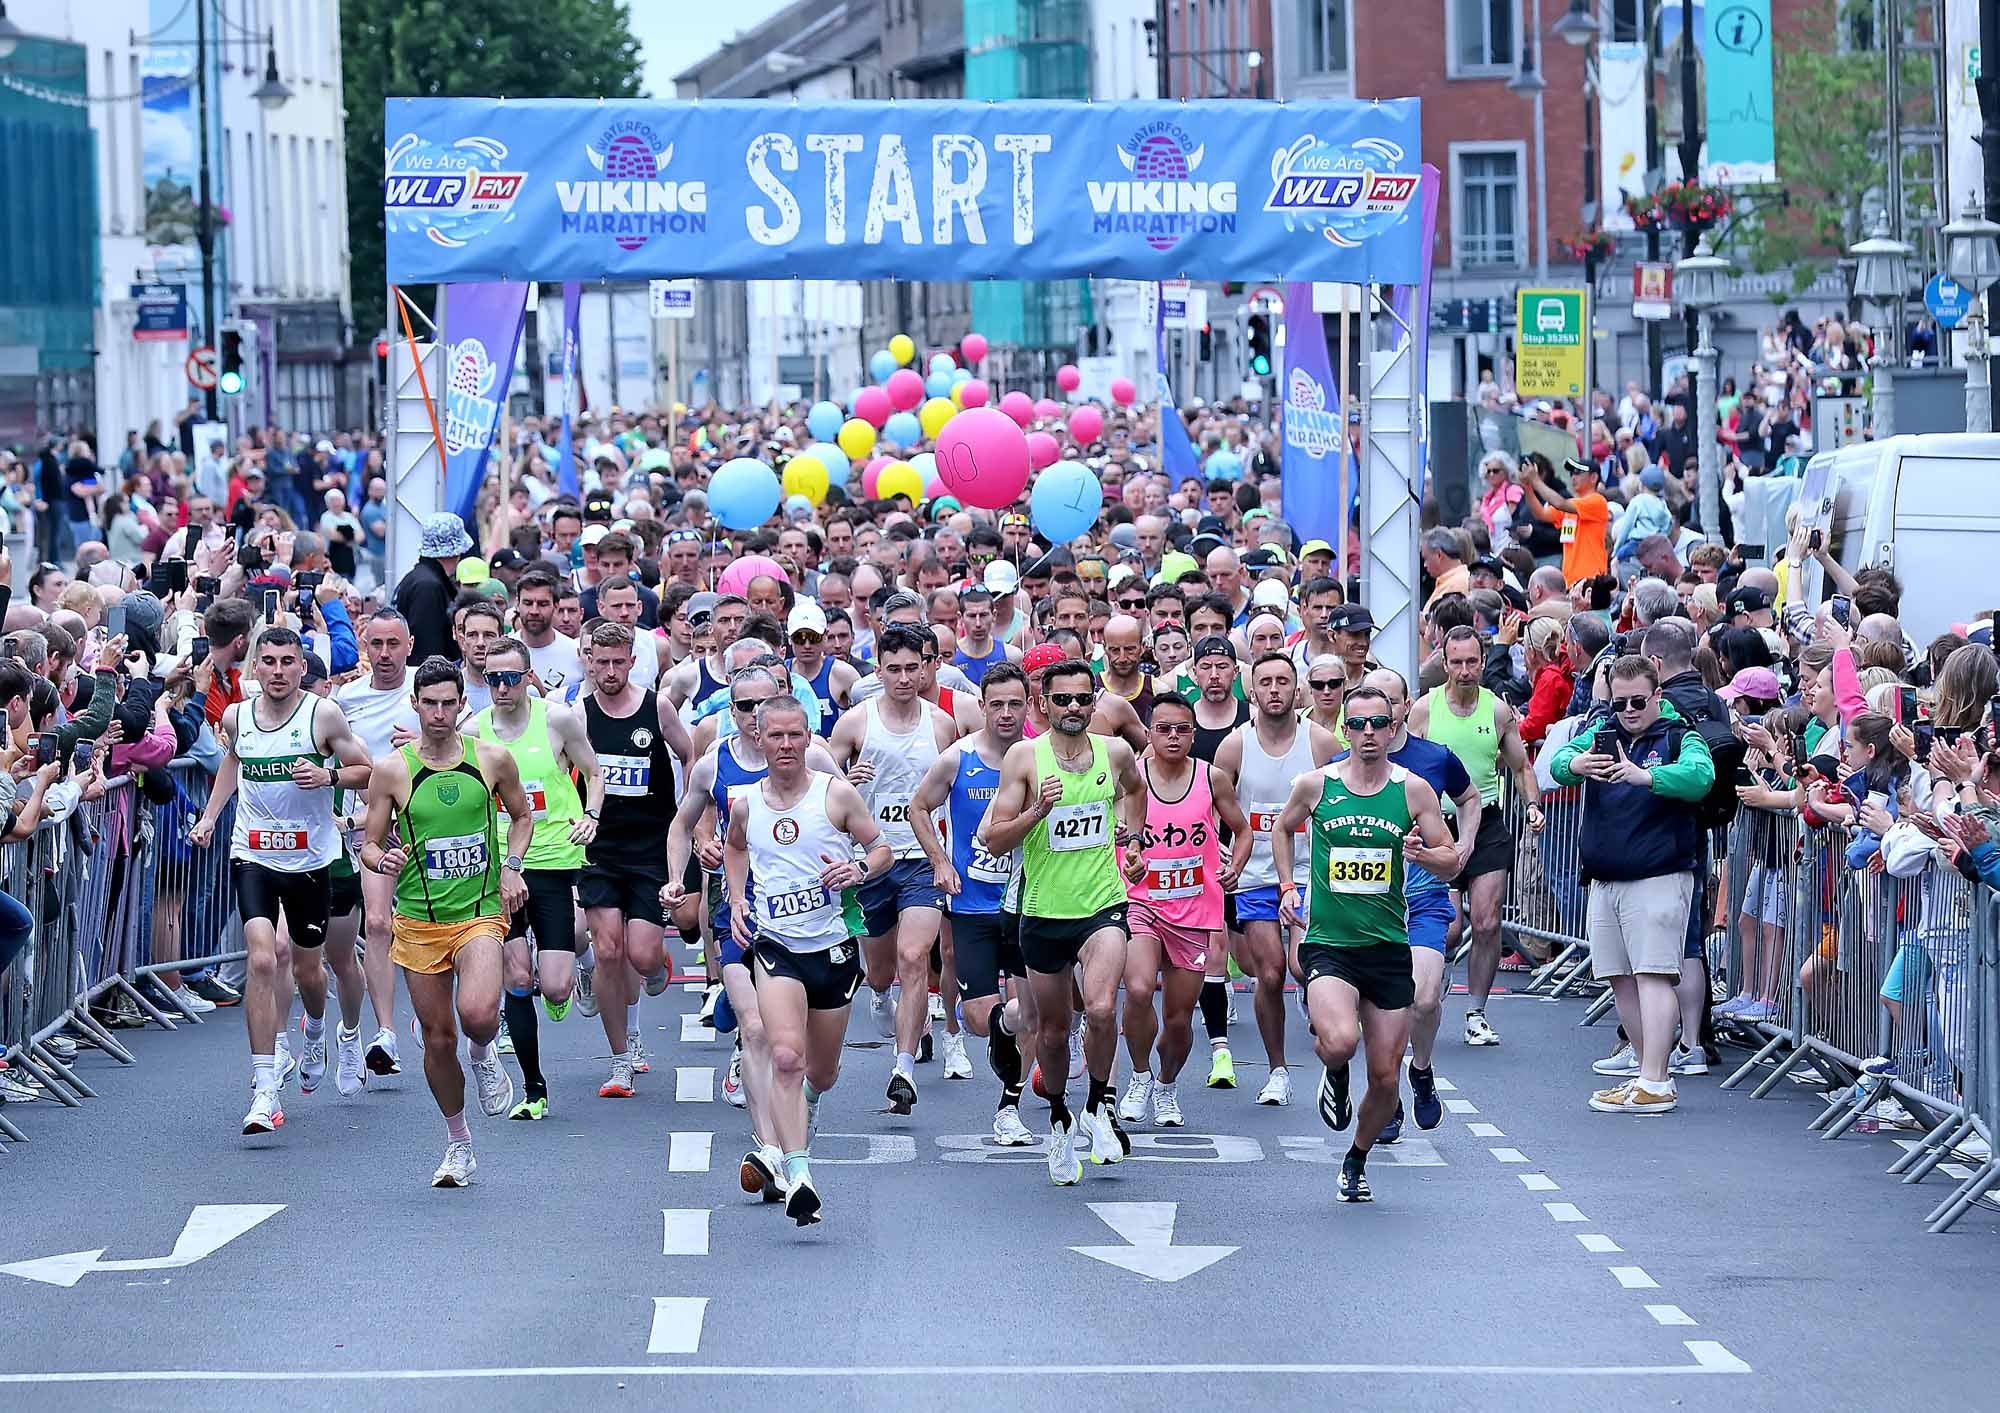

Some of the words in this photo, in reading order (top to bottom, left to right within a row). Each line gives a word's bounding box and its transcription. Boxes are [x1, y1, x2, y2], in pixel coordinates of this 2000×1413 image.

[596, 120, 662, 151] WATERFORD
[1126, 120, 1193, 151] WATERFORD
[405, 155, 433, 169] We
[436, 155, 468, 169] Are
[1302, 156, 1330, 170] We
[1334, 156, 1364, 170] Are
[386, 179, 462, 204] WLR
[477, 179, 508, 197] FM
[555, 181, 707, 212] VIKING
[745, 132, 1051, 246] START
[1086, 181, 1238, 213] VIKING
[1283, 179, 1359, 204] WLR
[1372, 181, 1408, 198] FM
[561, 213, 706, 233] MARATHON
[1093, 213, 1237, 233] MARATHON
[1522, 333, 1544, 345] Stop
[241, 762, 298, 777] RAHEN
[601, 766, 643, 786] 2211
[967, 787, 999, 801] WATER
[1054, 815, 1103, 839] 4277
[1143, 822, 1207, 849] ふわる
[1322, 815, 1404, 838] FERRYBANK
[1349, 826, 1373, 837] A.C.
[259, 831, 297, 850] 566
[431, 845, 482, 869] 1803
[973, 850, 1012, 873] 220
[443, 864, 481, 879] DAVID
[1159, 869, 1195, 889] 514
[1334, 861, 1386, 882] 3362
[771, 887, 825, 918] 2035
